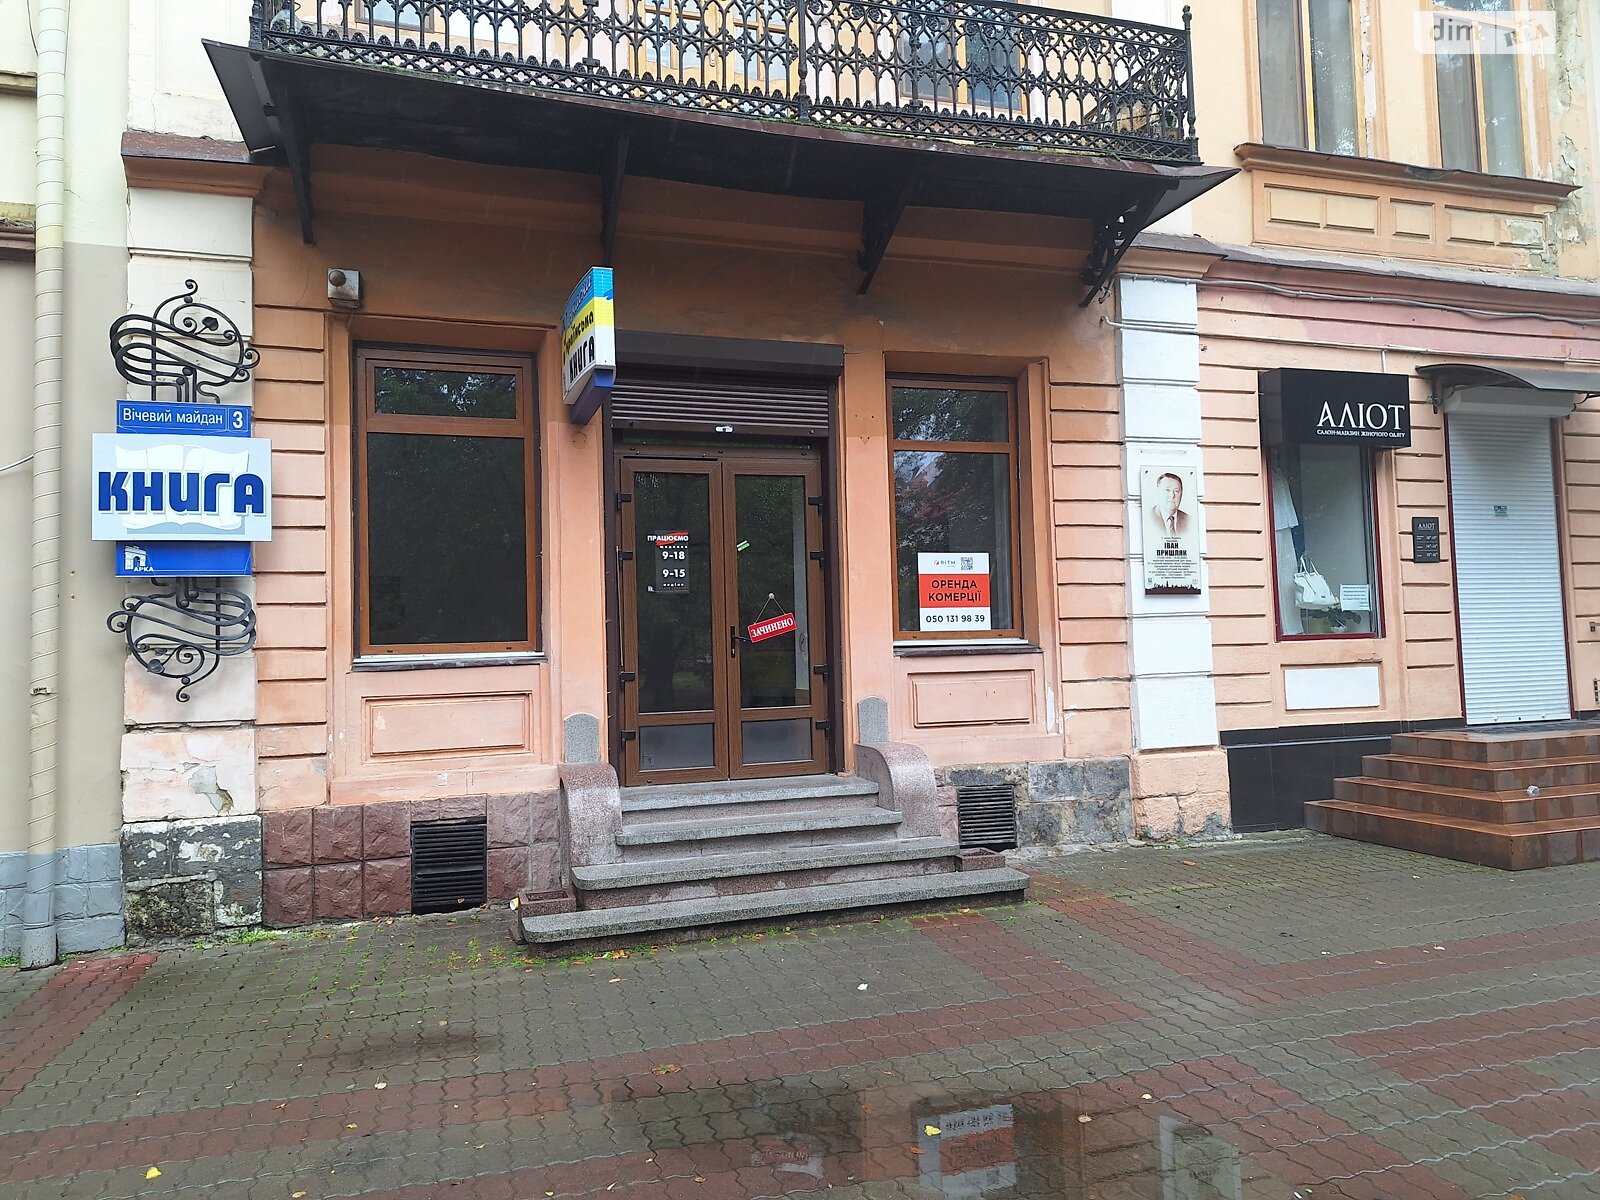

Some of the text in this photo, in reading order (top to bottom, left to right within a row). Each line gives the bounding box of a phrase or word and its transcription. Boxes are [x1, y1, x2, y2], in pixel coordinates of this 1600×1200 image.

[123, 408, 243, 429] Вічевий майдан 3
[98, 471, 264, 514] КНИГА
[662, 551, 686, 560] 9-18
[1156, 549, 1188, 557] ПРИШЛЯК
[662, 569, 686, 578] 9-15
[931, 579, 978, 590] ОРЕНДА
[928, 590, 982, 603] КОМЕРЦІЇ
[925, 614, 985, 623] 050 131 98 39
[750, 617, 794, 638] ЗАЧИНЕНО
